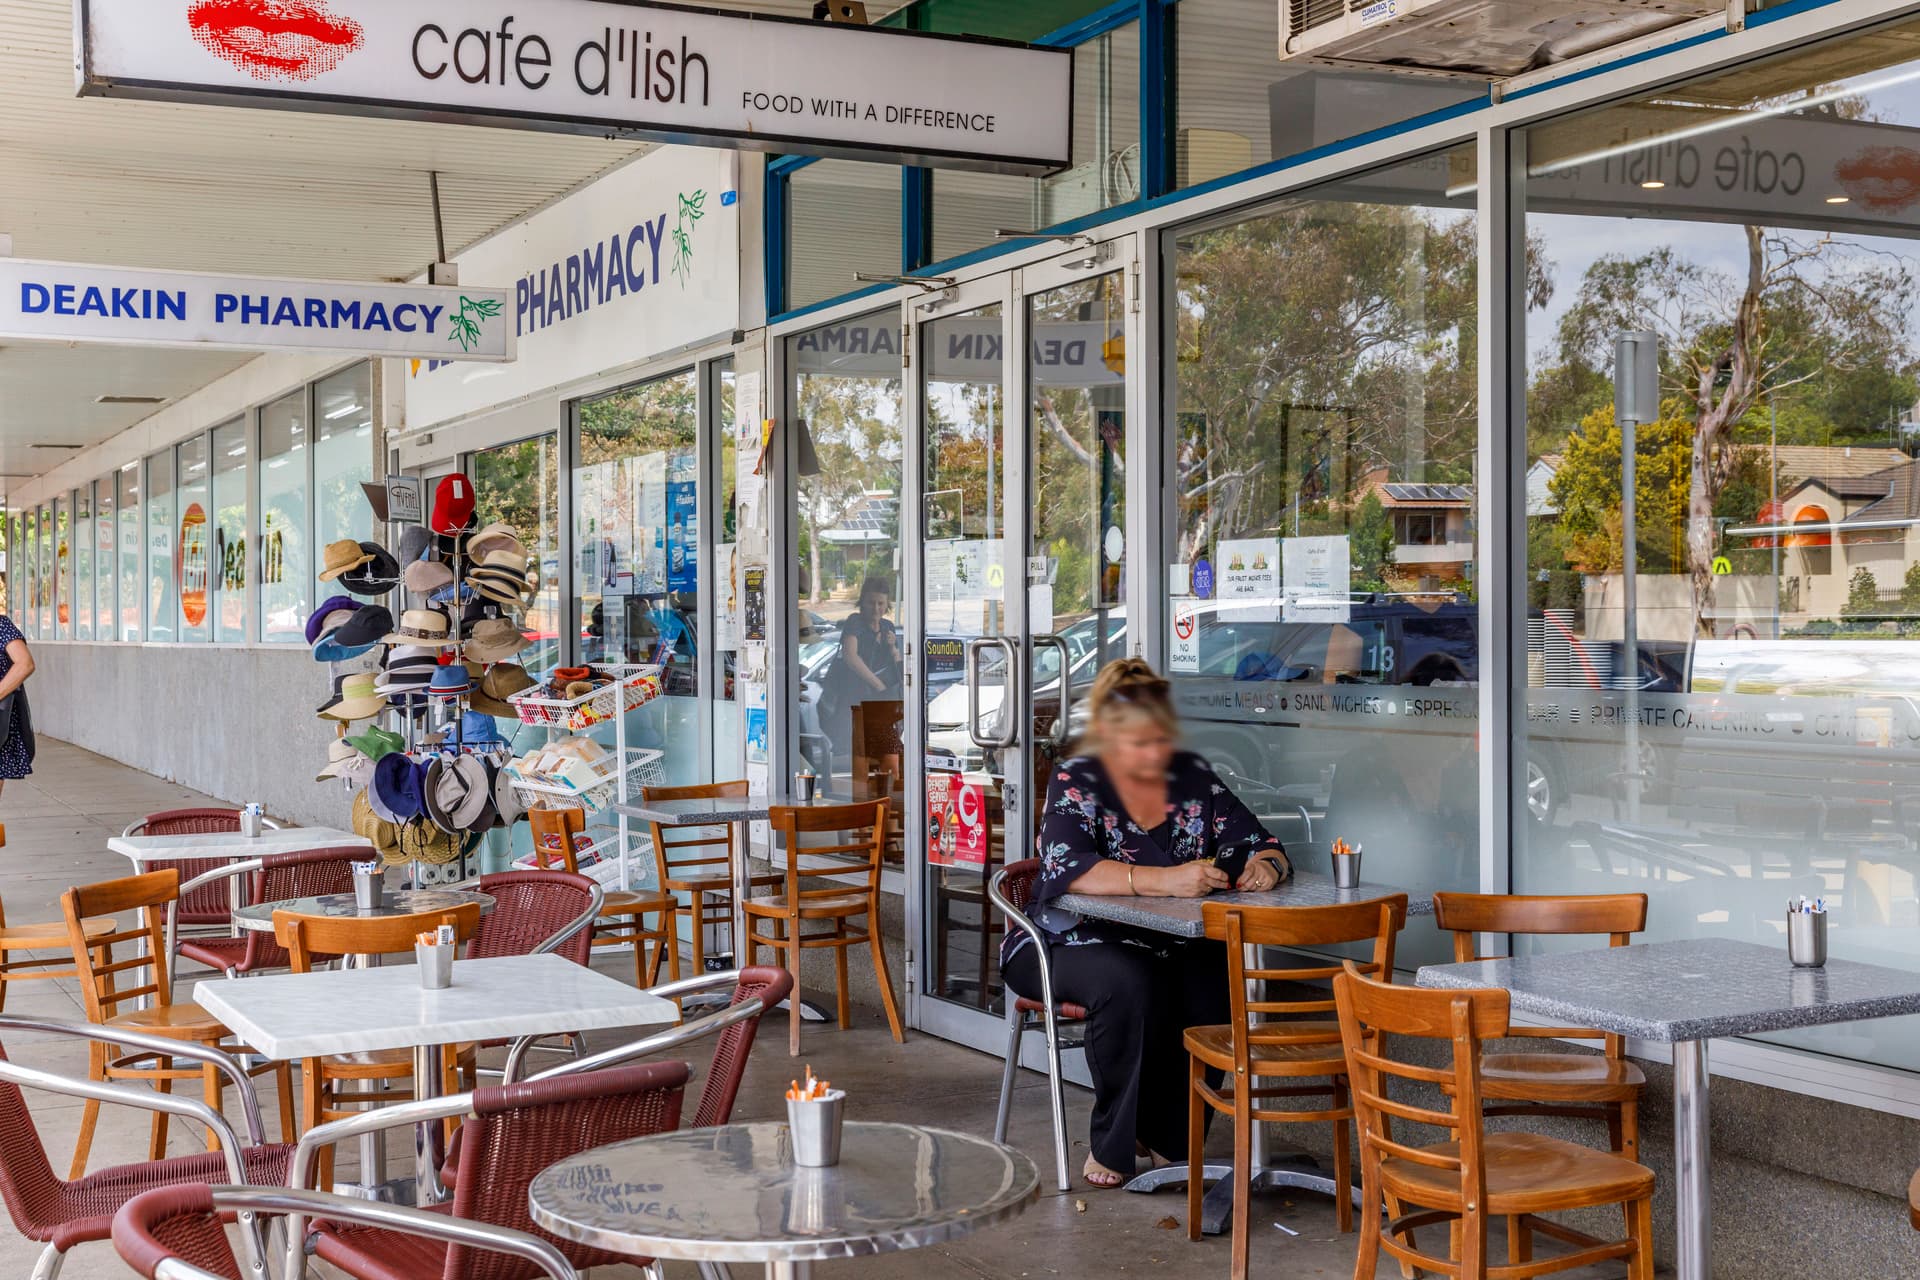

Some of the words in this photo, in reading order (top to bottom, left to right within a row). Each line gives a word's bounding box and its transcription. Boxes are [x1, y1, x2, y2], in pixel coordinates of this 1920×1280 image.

[412, 16, 551, 90] cafe
[575, 27, 709, 106] d'lish
[743, 92, 803, 114] FOOD
[811, 98, 857, 119] WITH
[864, 103, 877, 121] A
[886, 105, 995, 133] DIFFERENCE
[516, 213, 667, 338] PHARMACY
[21, 282, 187, 321] DEAKIN
[215, 293, 444, 334] PHARMACY
[1030, 562, 1044, 571] PULL
[927, 641, 963, 655] SoundOut
[1179, 643, 1189, 652] NO
[1172, 654, 1197, 663] SMOKING
[1235, 691, 1274, 710] MEALS
